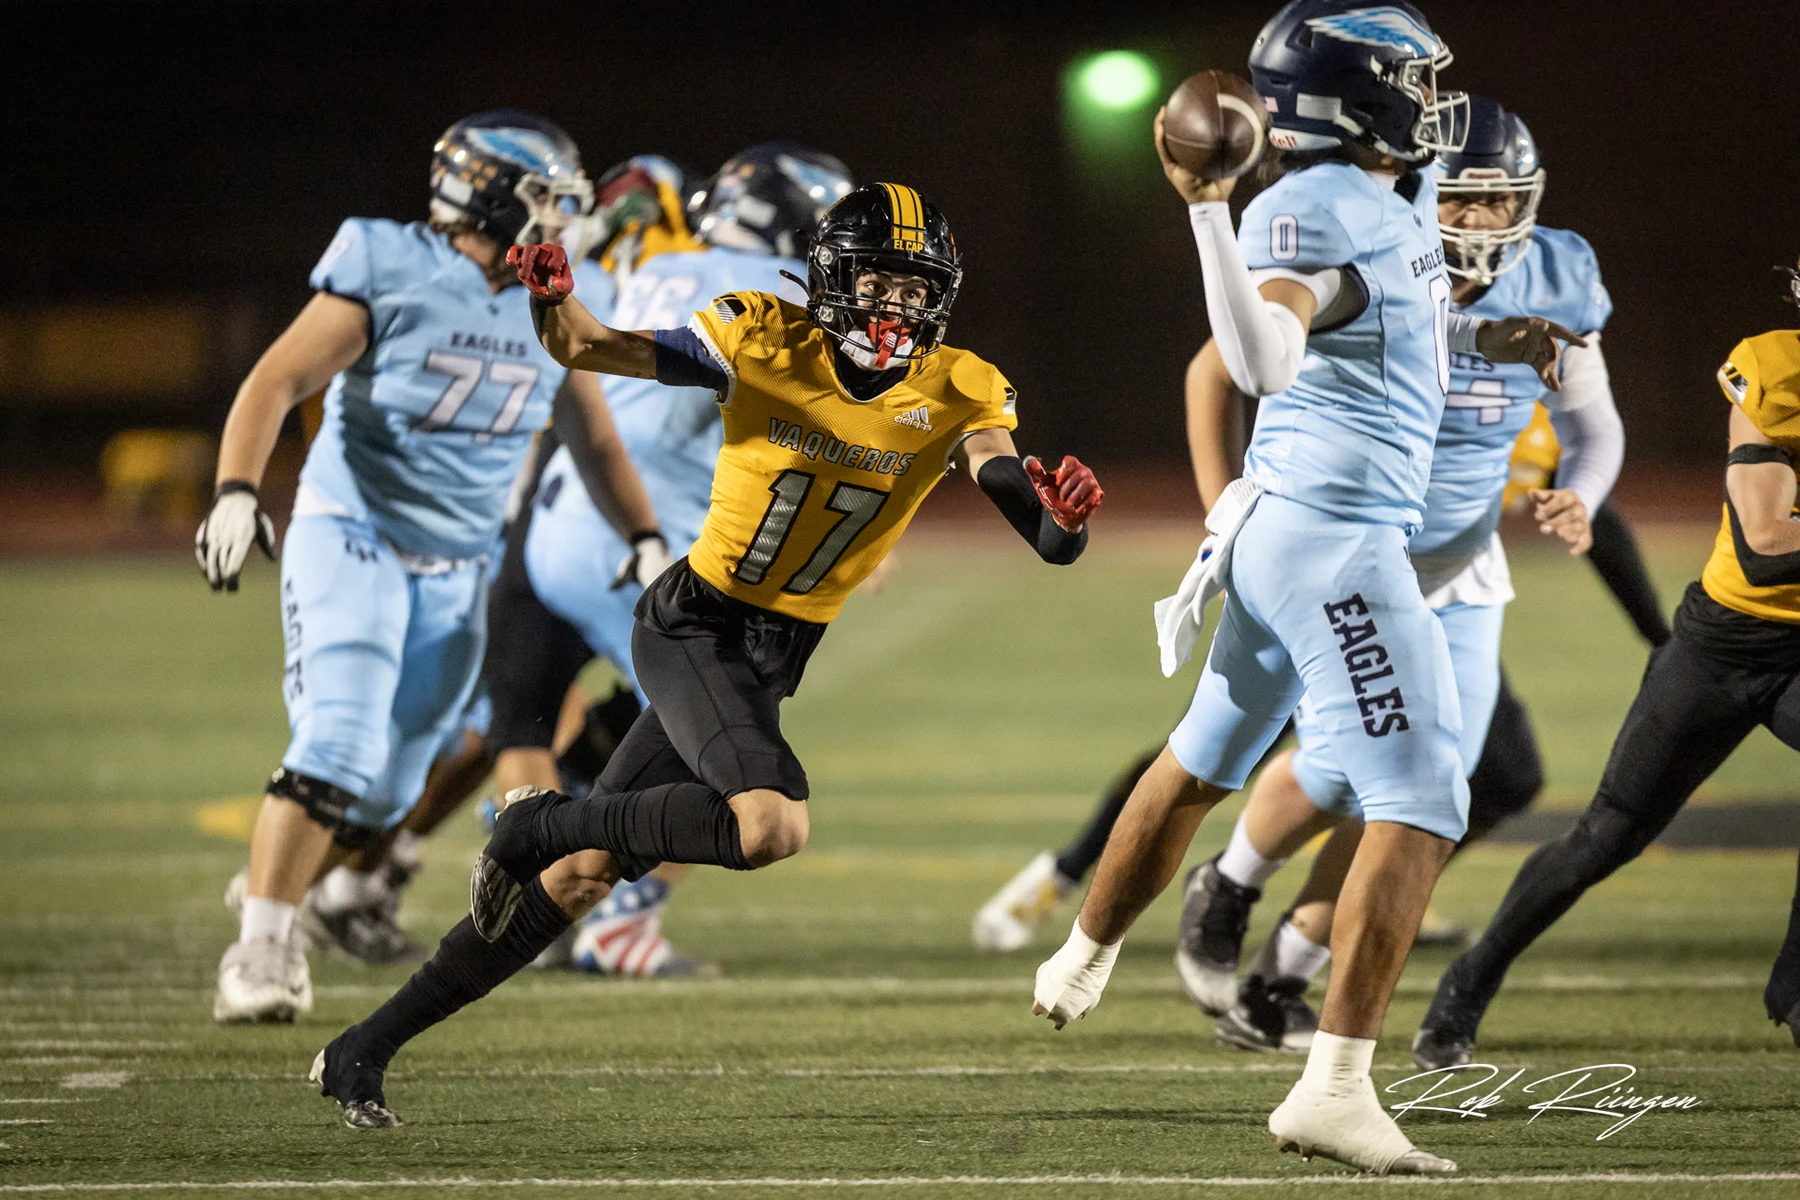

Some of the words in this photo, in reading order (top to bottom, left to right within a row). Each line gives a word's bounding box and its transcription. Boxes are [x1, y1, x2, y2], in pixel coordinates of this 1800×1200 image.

[893, 240, 904, 251] EL
[905, 241, 924, 253] CAP
[1269, 213, 1299, 262] 0
[451, 331, 528, 358] EAGLES
[420, 348, 541, 443] 77
[768, 417, 917, 476] VAQUEROS
[894, 415, 933, 432] adidas
[734, 468, 891, 596] 17
[1323, 592, 1410, 738] EAGLES
